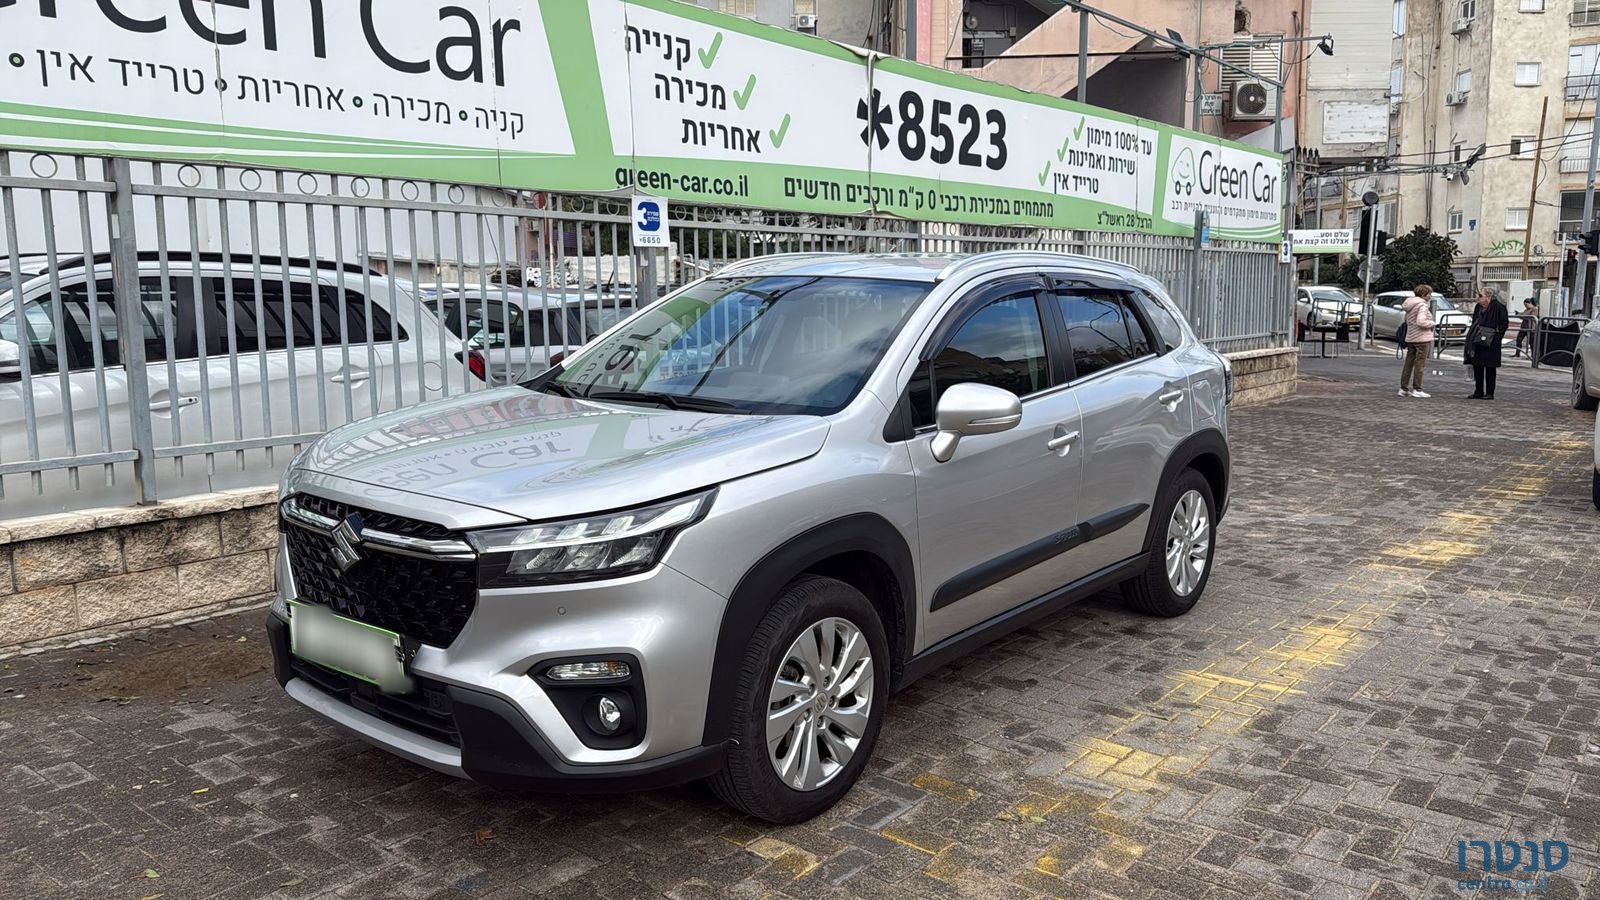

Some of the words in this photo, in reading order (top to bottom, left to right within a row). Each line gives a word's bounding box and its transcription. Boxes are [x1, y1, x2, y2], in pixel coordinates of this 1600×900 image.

[360, 0, 521, 88] Car
[624, 25, 691, 71] קנייה
[36, 49, 97, 88] אין
[108, 57, 205, 95] טרייד
[236, 74, 346, 113] אחריות
[654, 73, 727, 110] מכירה
[373, 92, 452, 125] מכירה
[474, 107, 525, 140] קניה
[681, 117, 761, 153] אחריות
[1086, 126, 1112, 149] מימון
[1141, 137, 1153, 156] עד
[1067, 148, 1106, 171] ואמינות
[1108, 156, 1136, 176] שירות
[615, 167, 749, 197] green-car.co.il
[784, 177, 841, 202] חדשים
[1053, 171, 1069, 195] אין
[1072, 175, 1099, 194] טרייד
[1199, 150, 1249, 200] Green
[1252, 161, 1278, 205] Car
[846, 185, 894, 206] ורכבים
[939, 192, 967, 212] רכבי
[968, 196, 1010, 216] במכירת
[1013, 199, 1054, 218] מתמחים
[1126, 213, 1135, 228] 28
[1136, 213, 1153, 230] הרצל
